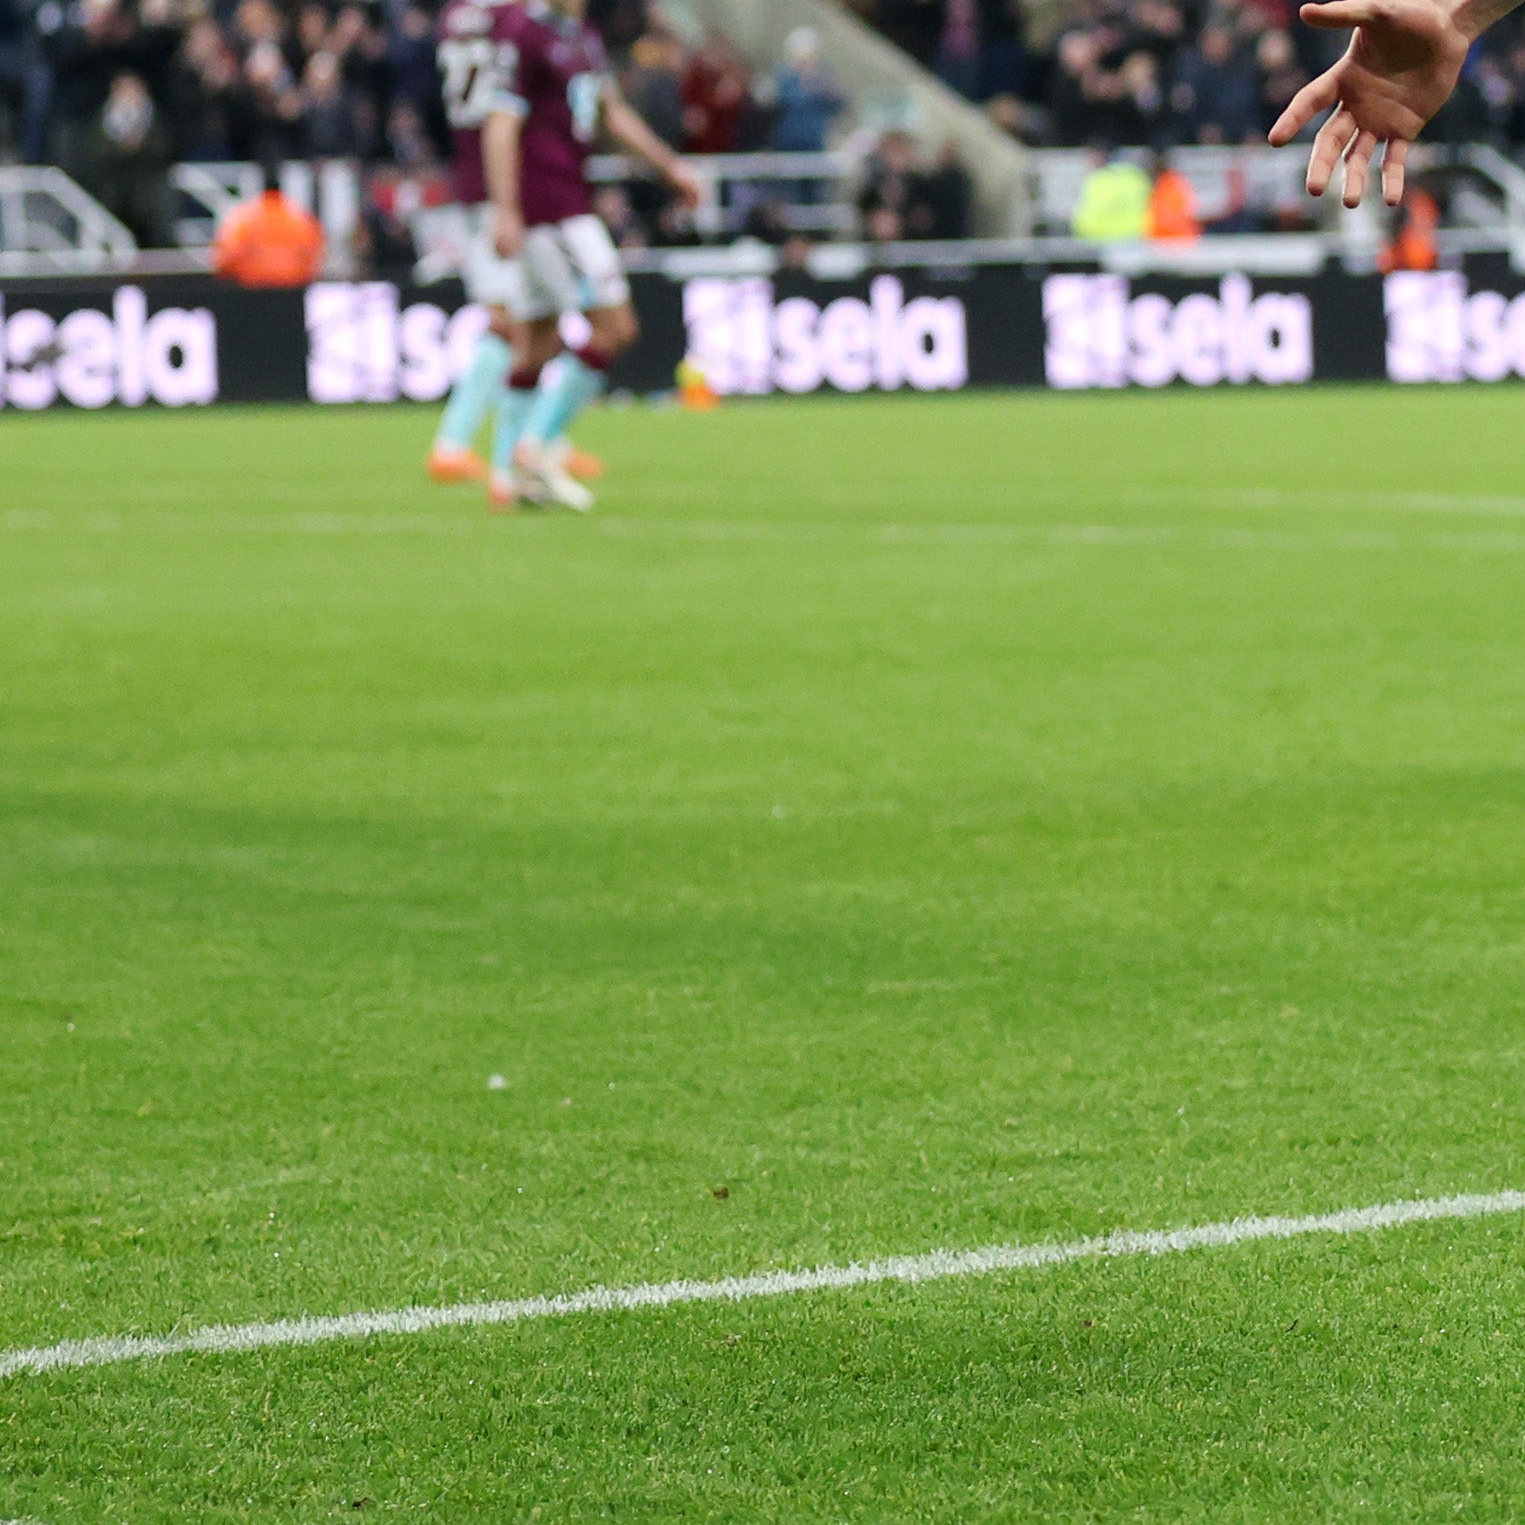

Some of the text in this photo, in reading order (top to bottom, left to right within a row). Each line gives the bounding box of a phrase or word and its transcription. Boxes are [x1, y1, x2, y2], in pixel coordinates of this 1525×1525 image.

[4, 284, 219, 409] sela
[773, 275, 968, 392] sela
[1128, 275, 1314, 386] sela
